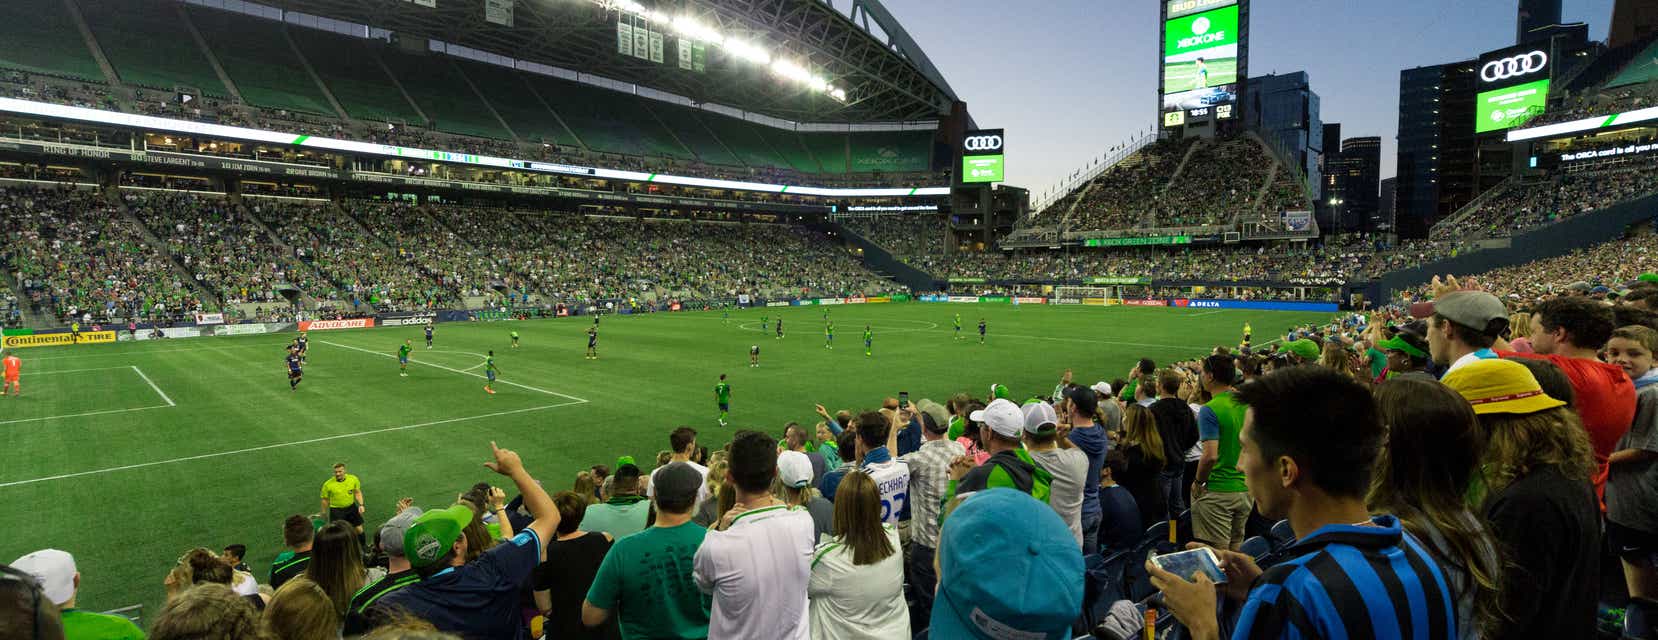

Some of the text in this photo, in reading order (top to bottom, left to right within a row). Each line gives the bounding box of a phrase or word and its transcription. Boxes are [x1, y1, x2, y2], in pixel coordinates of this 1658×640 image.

[1172, 1, 1196, 12] BUD
[1177, 31, 1225, 48] XBOX ONE
[43, 145, 111, 158] RING OF HONOR
[1576, 151, 1598, 159] ORCA
[1598, 147, 1616, 156] card
[1624, 145, 1635, 153] all
[1635, 144, 1651, 153] you
[143, 155, 163, 164] STEVE
[163, 157, 190, 166] LARGENT
[311, 318, 365, 329] ADVOCARE
[87, 333, 113, 341] TIRE
